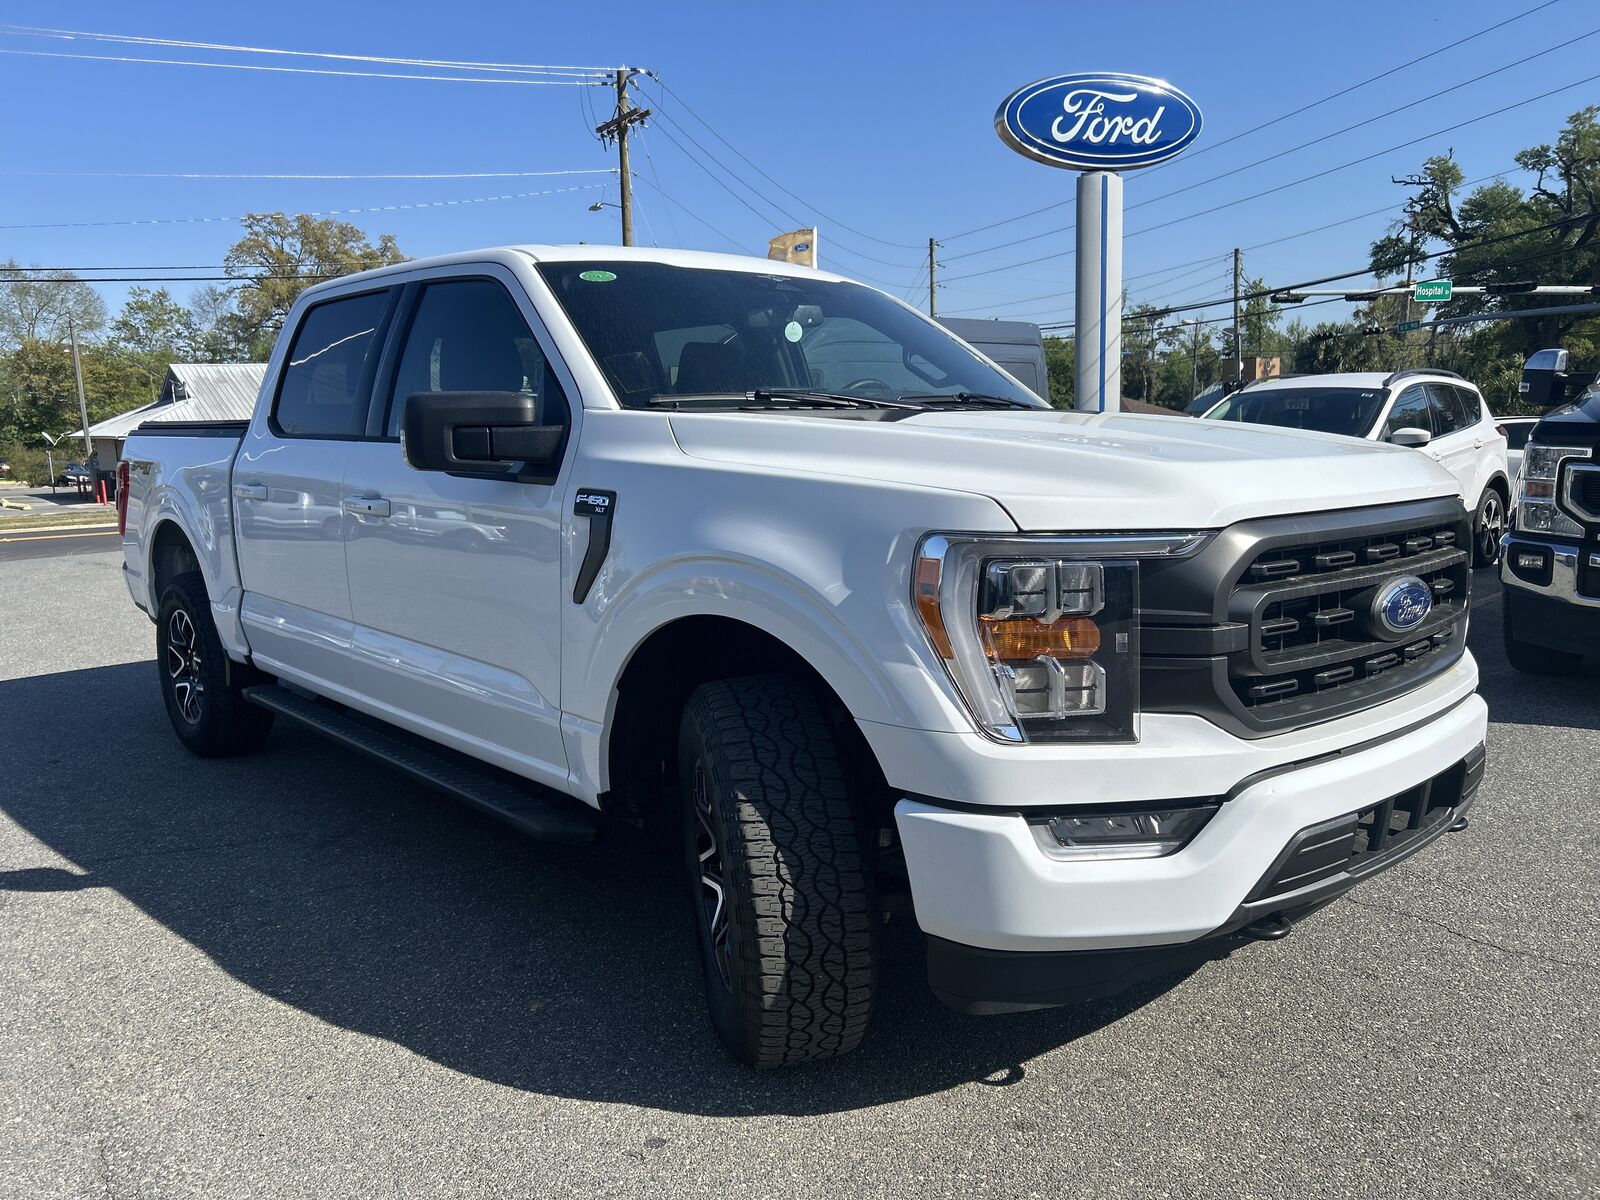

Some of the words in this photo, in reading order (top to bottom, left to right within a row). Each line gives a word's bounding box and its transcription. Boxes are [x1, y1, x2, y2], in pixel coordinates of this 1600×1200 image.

[1051, 89, 1165, 144] Ford
[1416, 286, 1443, 297] Hospital
[1398, 593, 1425, 621] Ford
